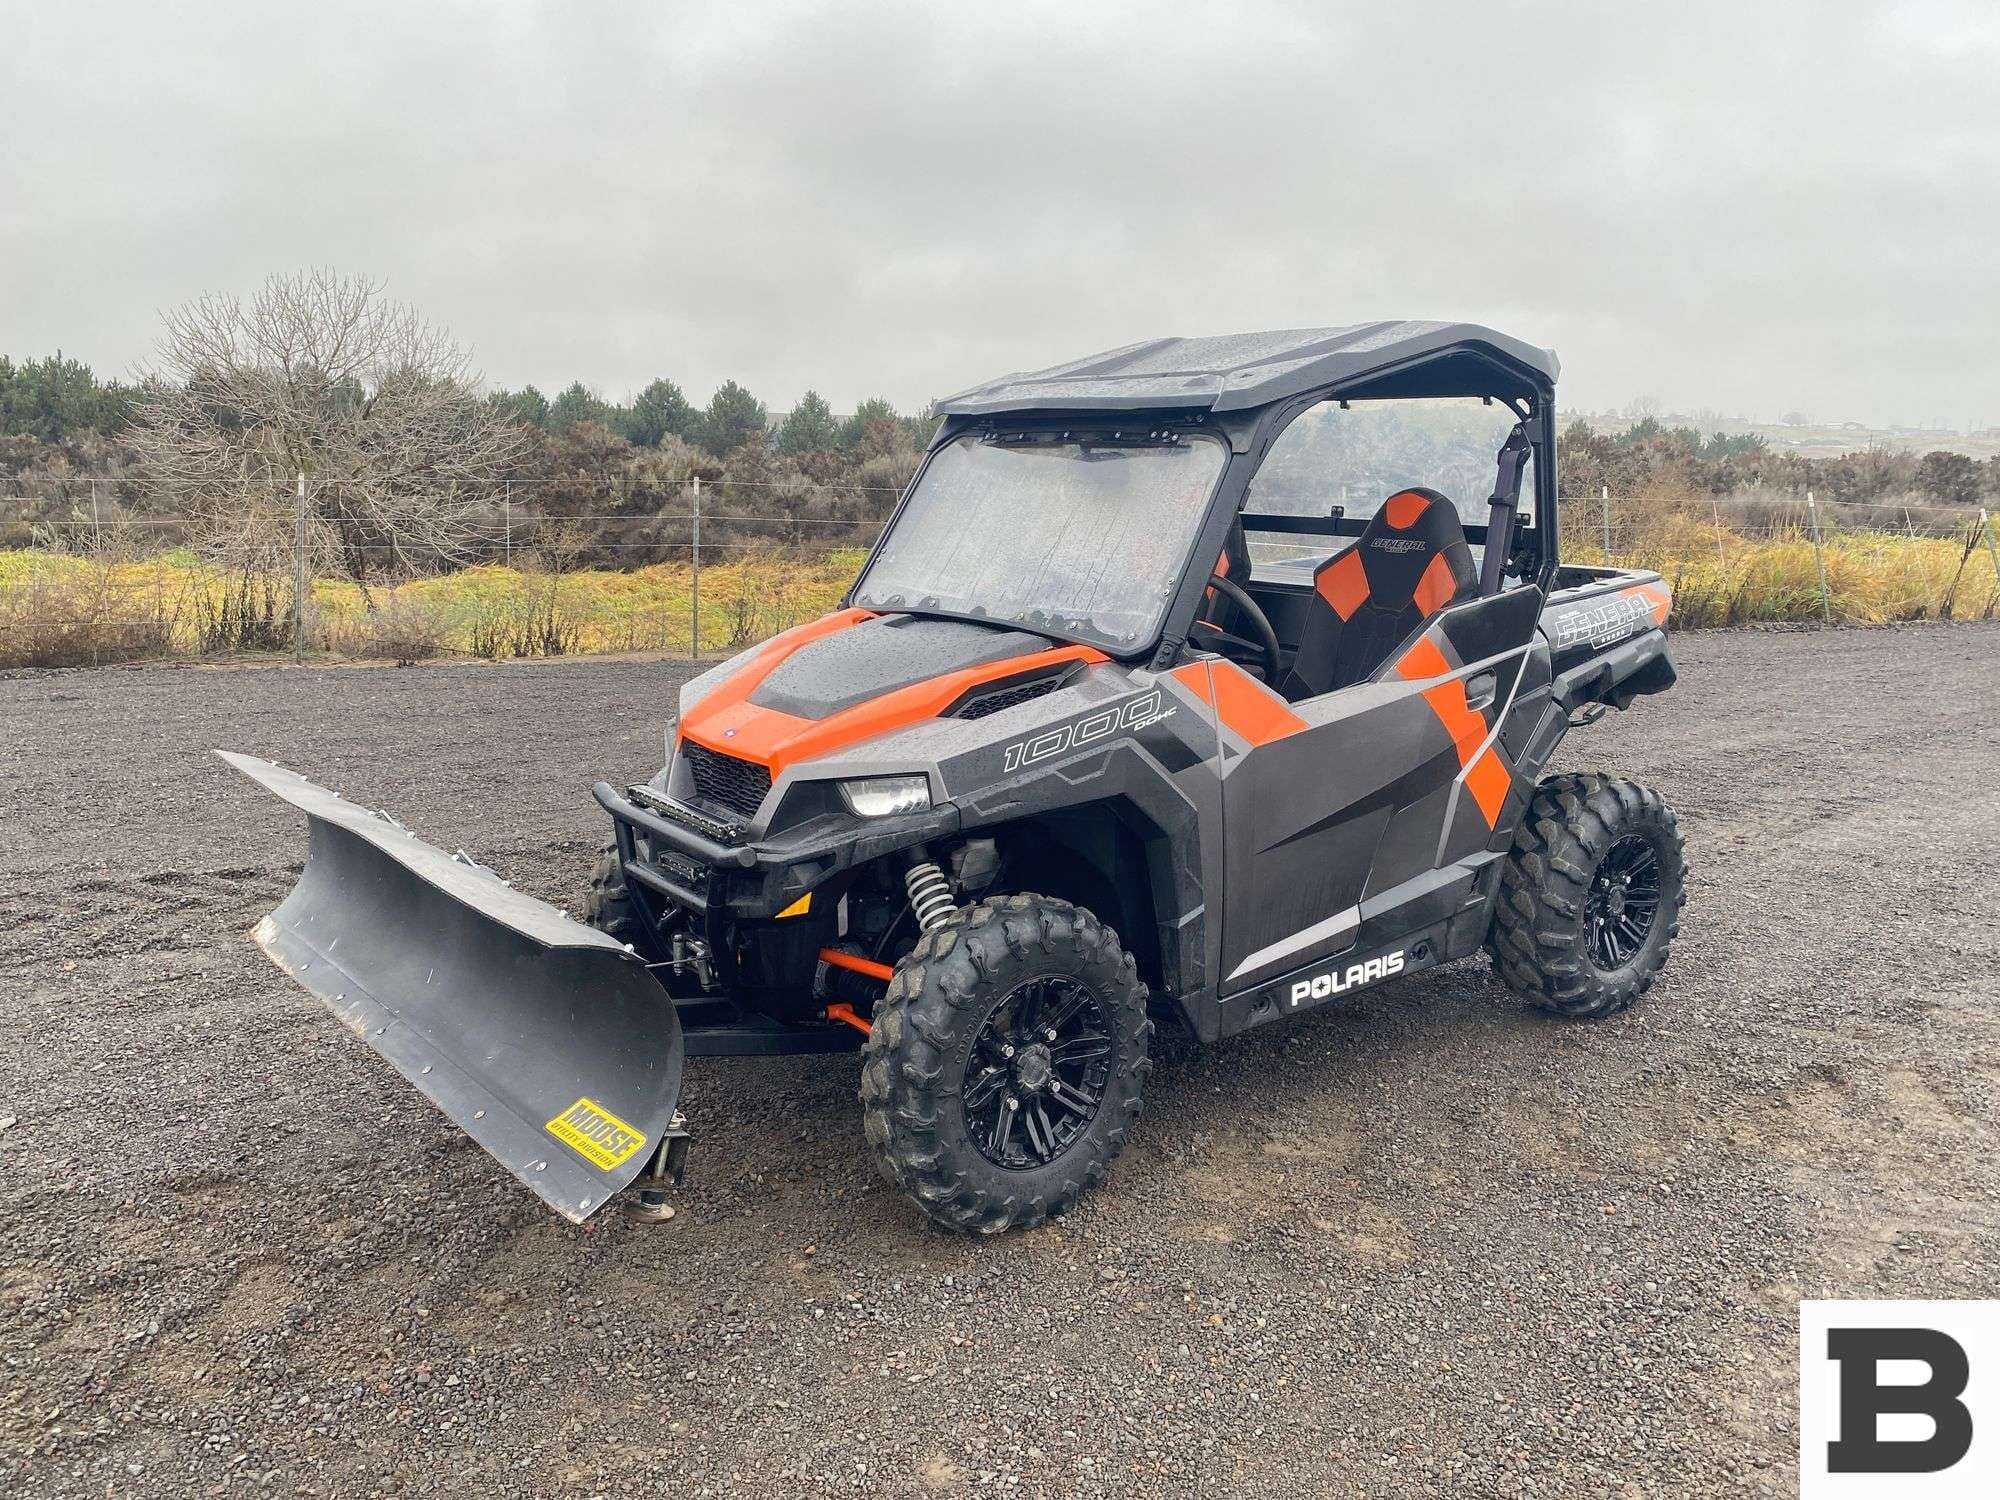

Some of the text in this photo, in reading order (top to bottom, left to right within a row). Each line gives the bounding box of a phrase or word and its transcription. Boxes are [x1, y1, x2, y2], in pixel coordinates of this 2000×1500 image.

[1370, 538, 1426, 551] GENERAL
[1555, 594, 1658, 648] GENERAL
[1004, 690, 1162, 773] 1000
[1133, 706, 1177, 732] DOHC
[1291, 949, 1405, 1007] POLARIS
[562, 1103, 641, 1158] MOOSE
[578, 1138, 616, 1167] DIVISION
